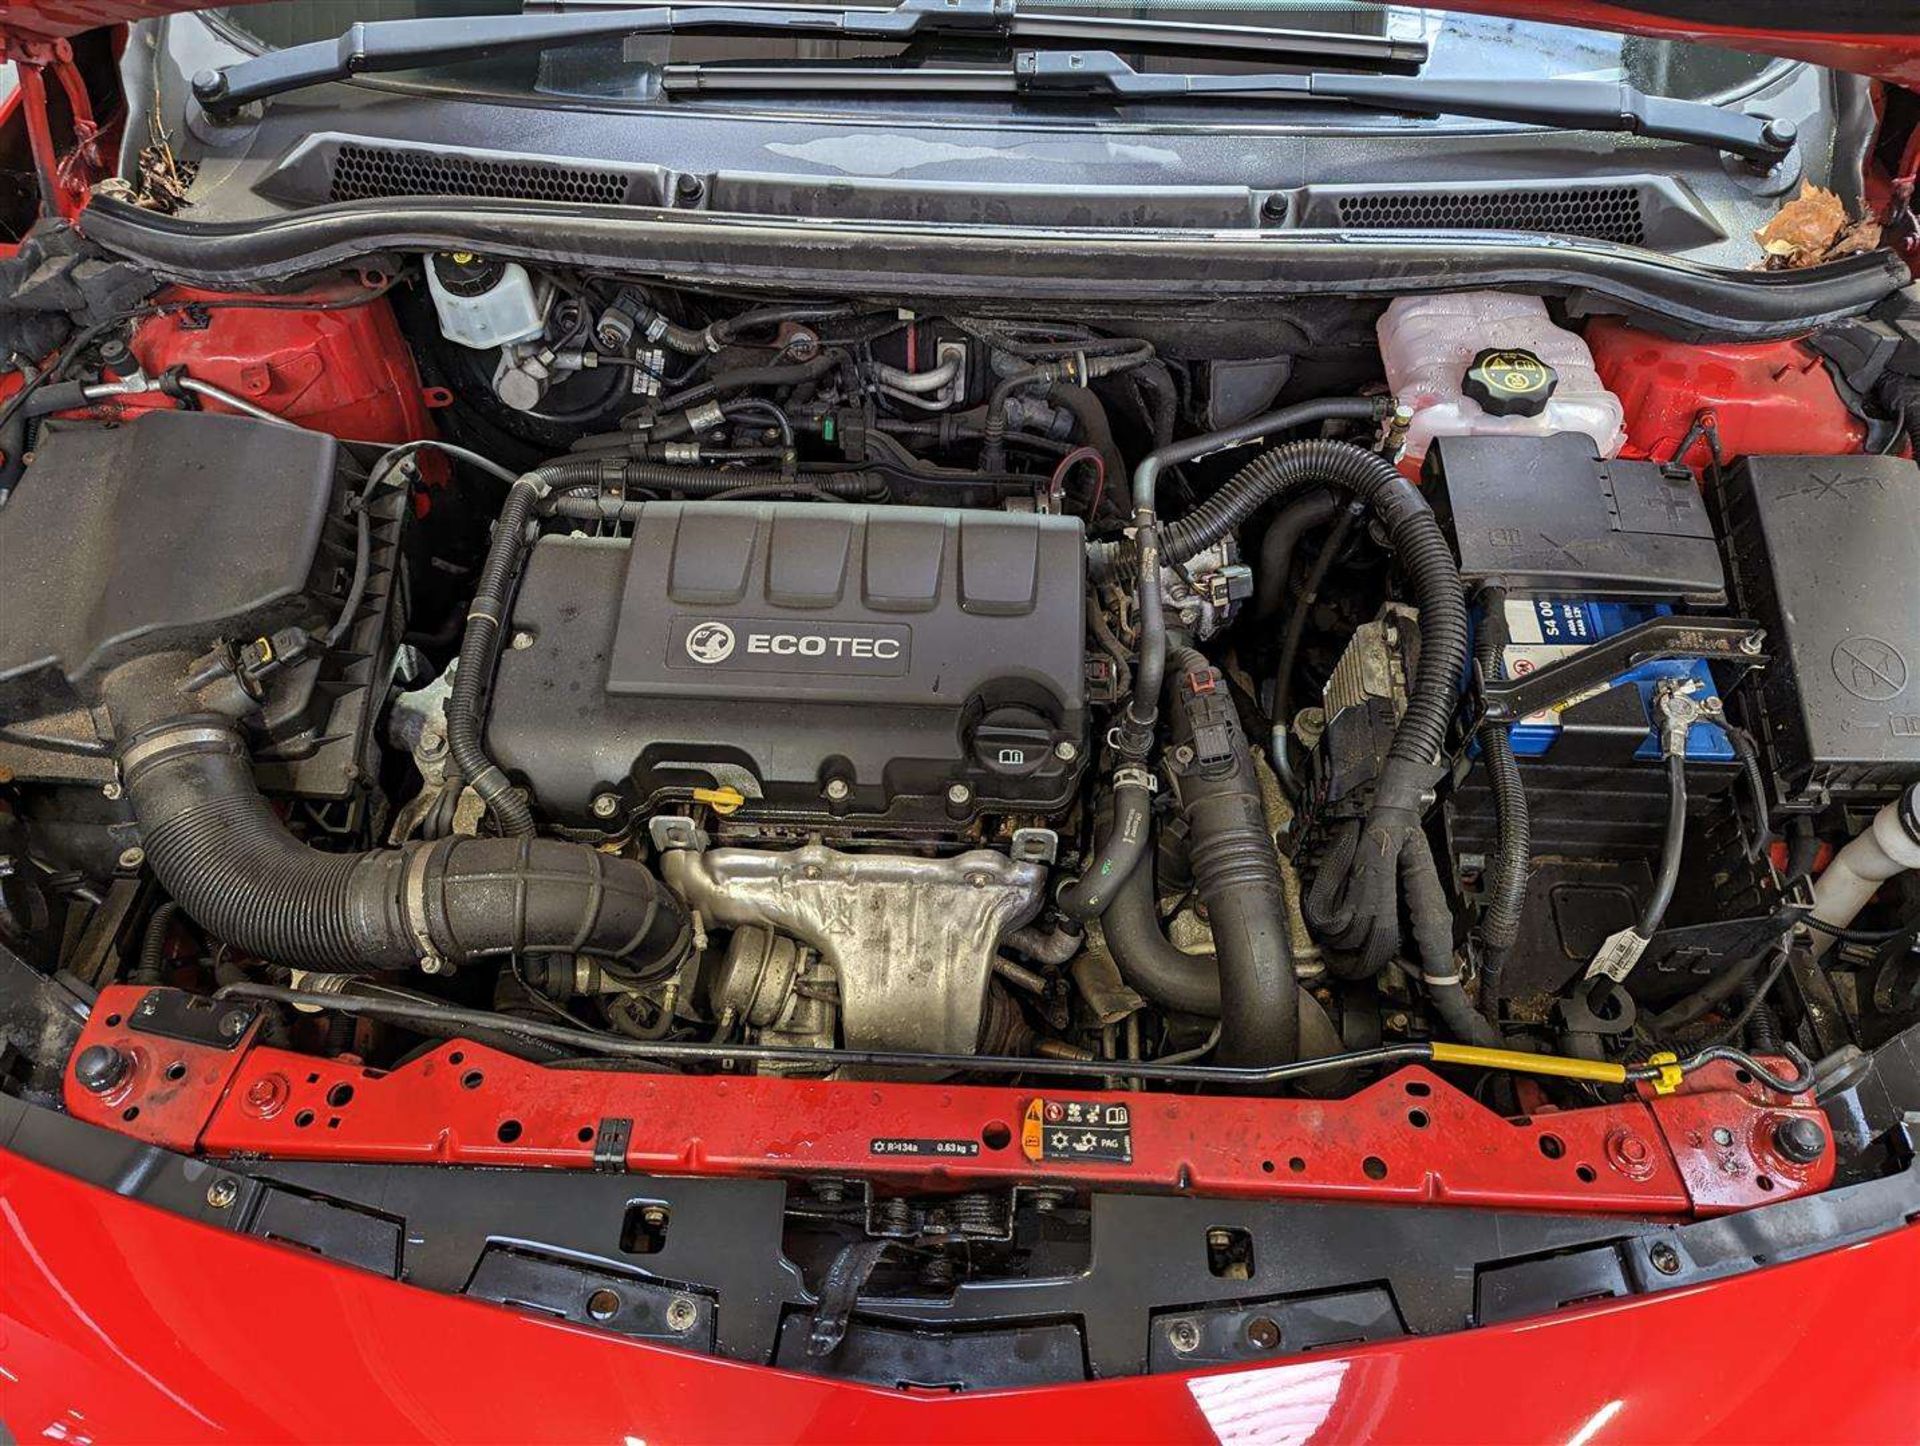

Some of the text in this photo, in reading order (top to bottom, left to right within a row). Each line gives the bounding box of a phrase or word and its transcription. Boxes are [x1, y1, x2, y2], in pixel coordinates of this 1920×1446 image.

[1543, 619, 1560, 636] S4
[747, 634, 900, 659] ECOTEC
[1100, 1138, 1119, 1148] PAG
